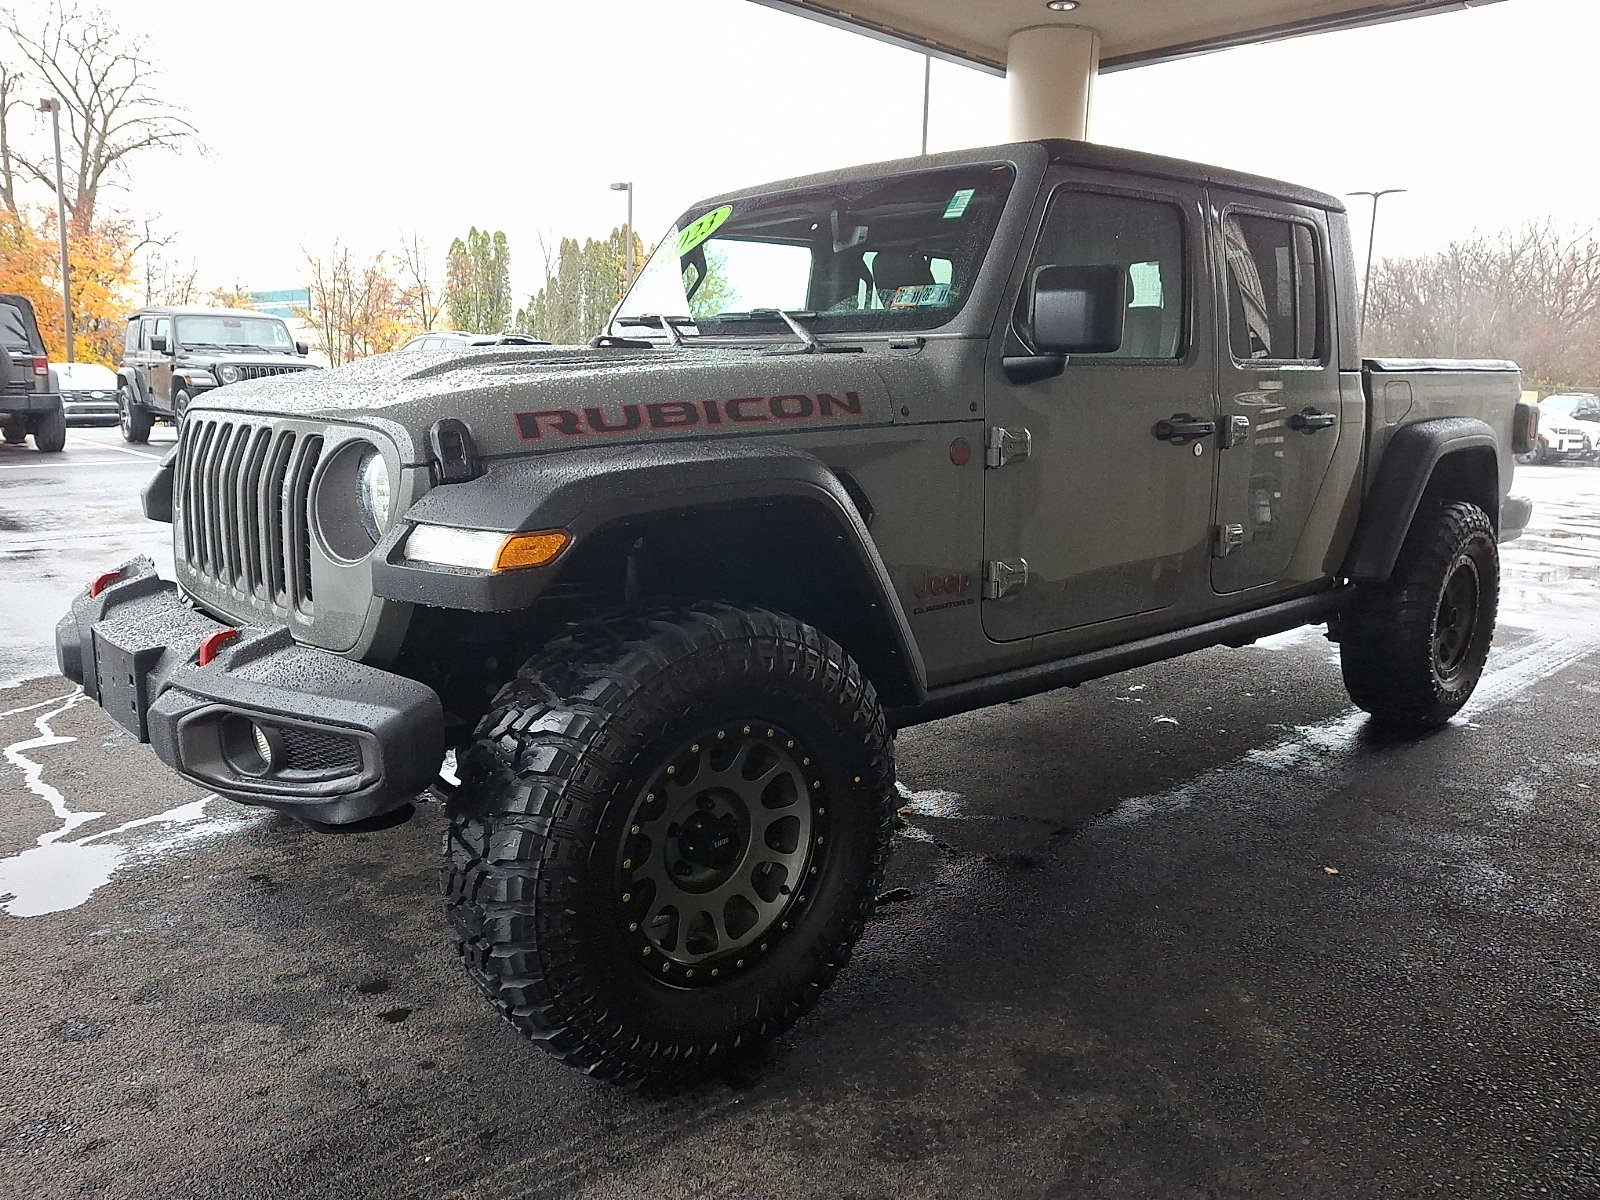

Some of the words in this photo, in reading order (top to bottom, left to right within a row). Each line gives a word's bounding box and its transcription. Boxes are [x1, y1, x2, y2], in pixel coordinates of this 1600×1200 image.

[671, 212, 719, 254] 023
[513, 391, 864, 442] RUBICON
[912, 571, 973, 598] Jeep
